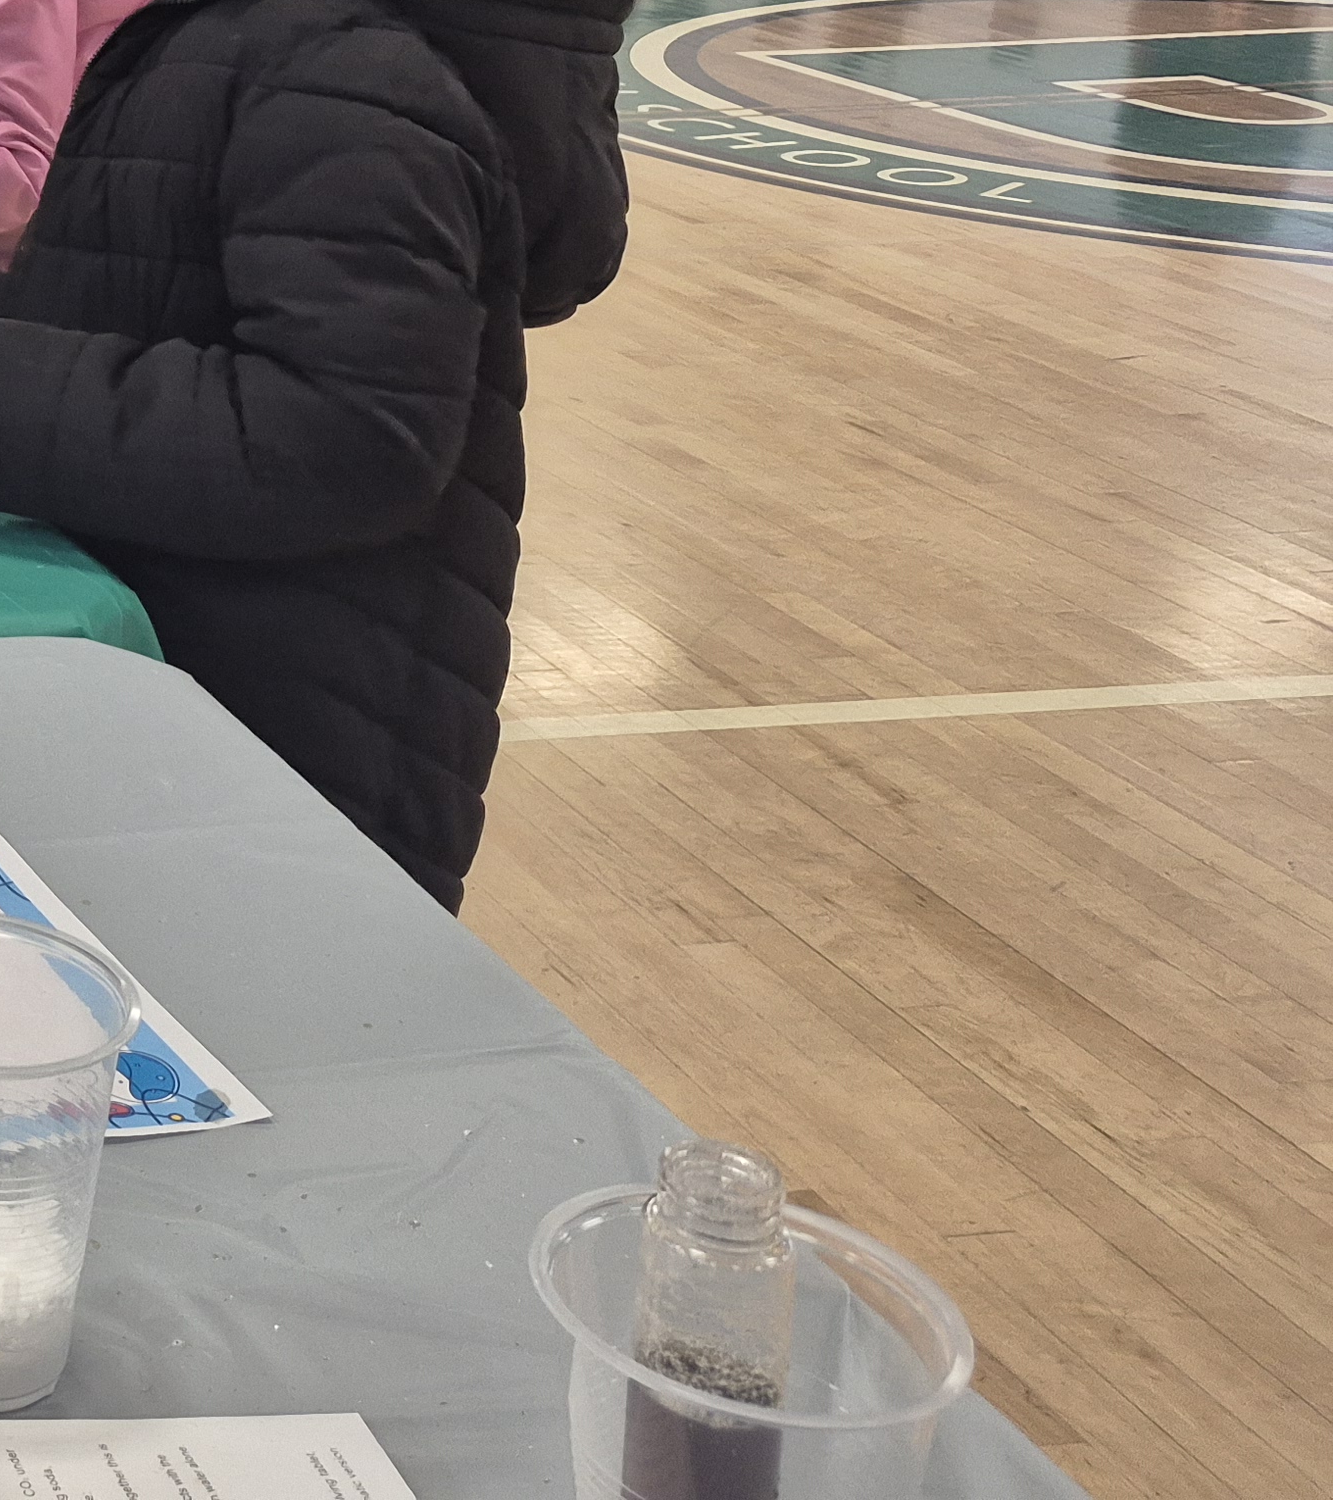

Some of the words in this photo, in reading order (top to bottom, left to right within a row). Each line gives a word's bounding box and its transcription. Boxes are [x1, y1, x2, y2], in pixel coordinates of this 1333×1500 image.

[6, 1449, 25, 1475] under
[330, 1448, 356, 1479] version
[194, 1470, 216, 1492] water
